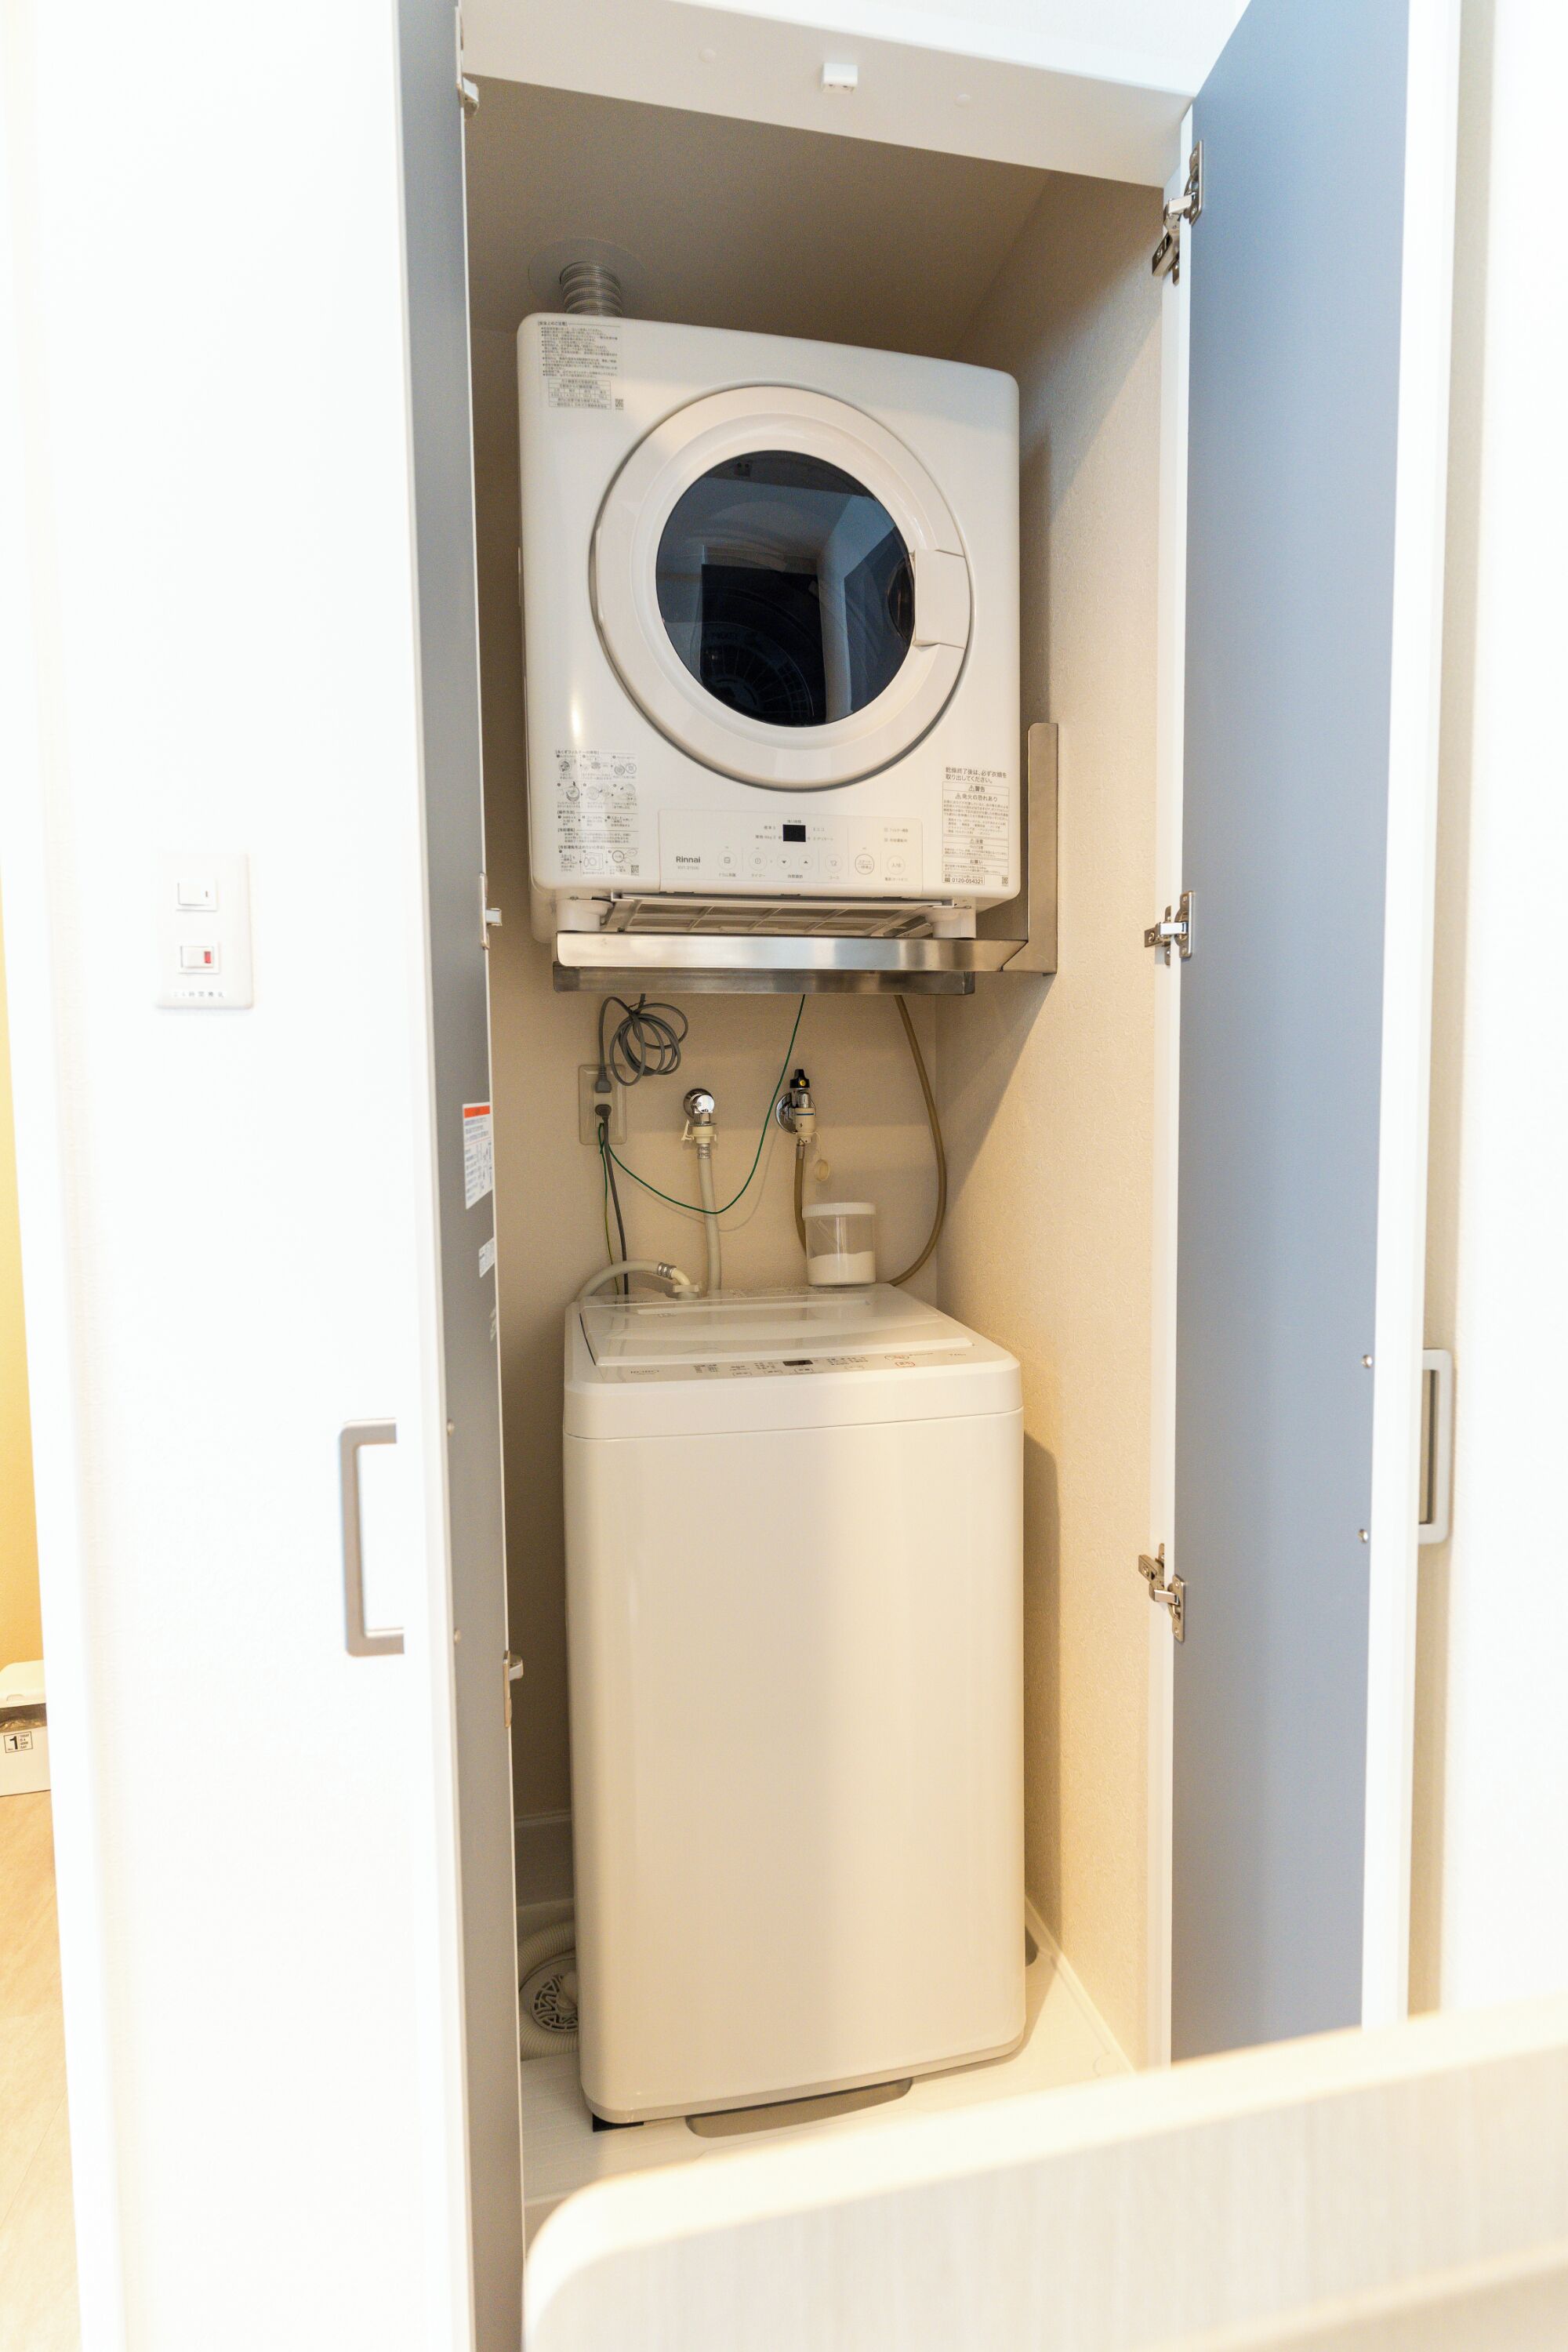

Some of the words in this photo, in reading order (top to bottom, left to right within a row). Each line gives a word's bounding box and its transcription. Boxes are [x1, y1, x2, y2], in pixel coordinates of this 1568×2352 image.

[946, 767, 1007, 779] 乾燥終了後は、必ず衣類を
[946, 774, 993, 783] 取り出してください。
[9, 1736, 18, 1750] 1
